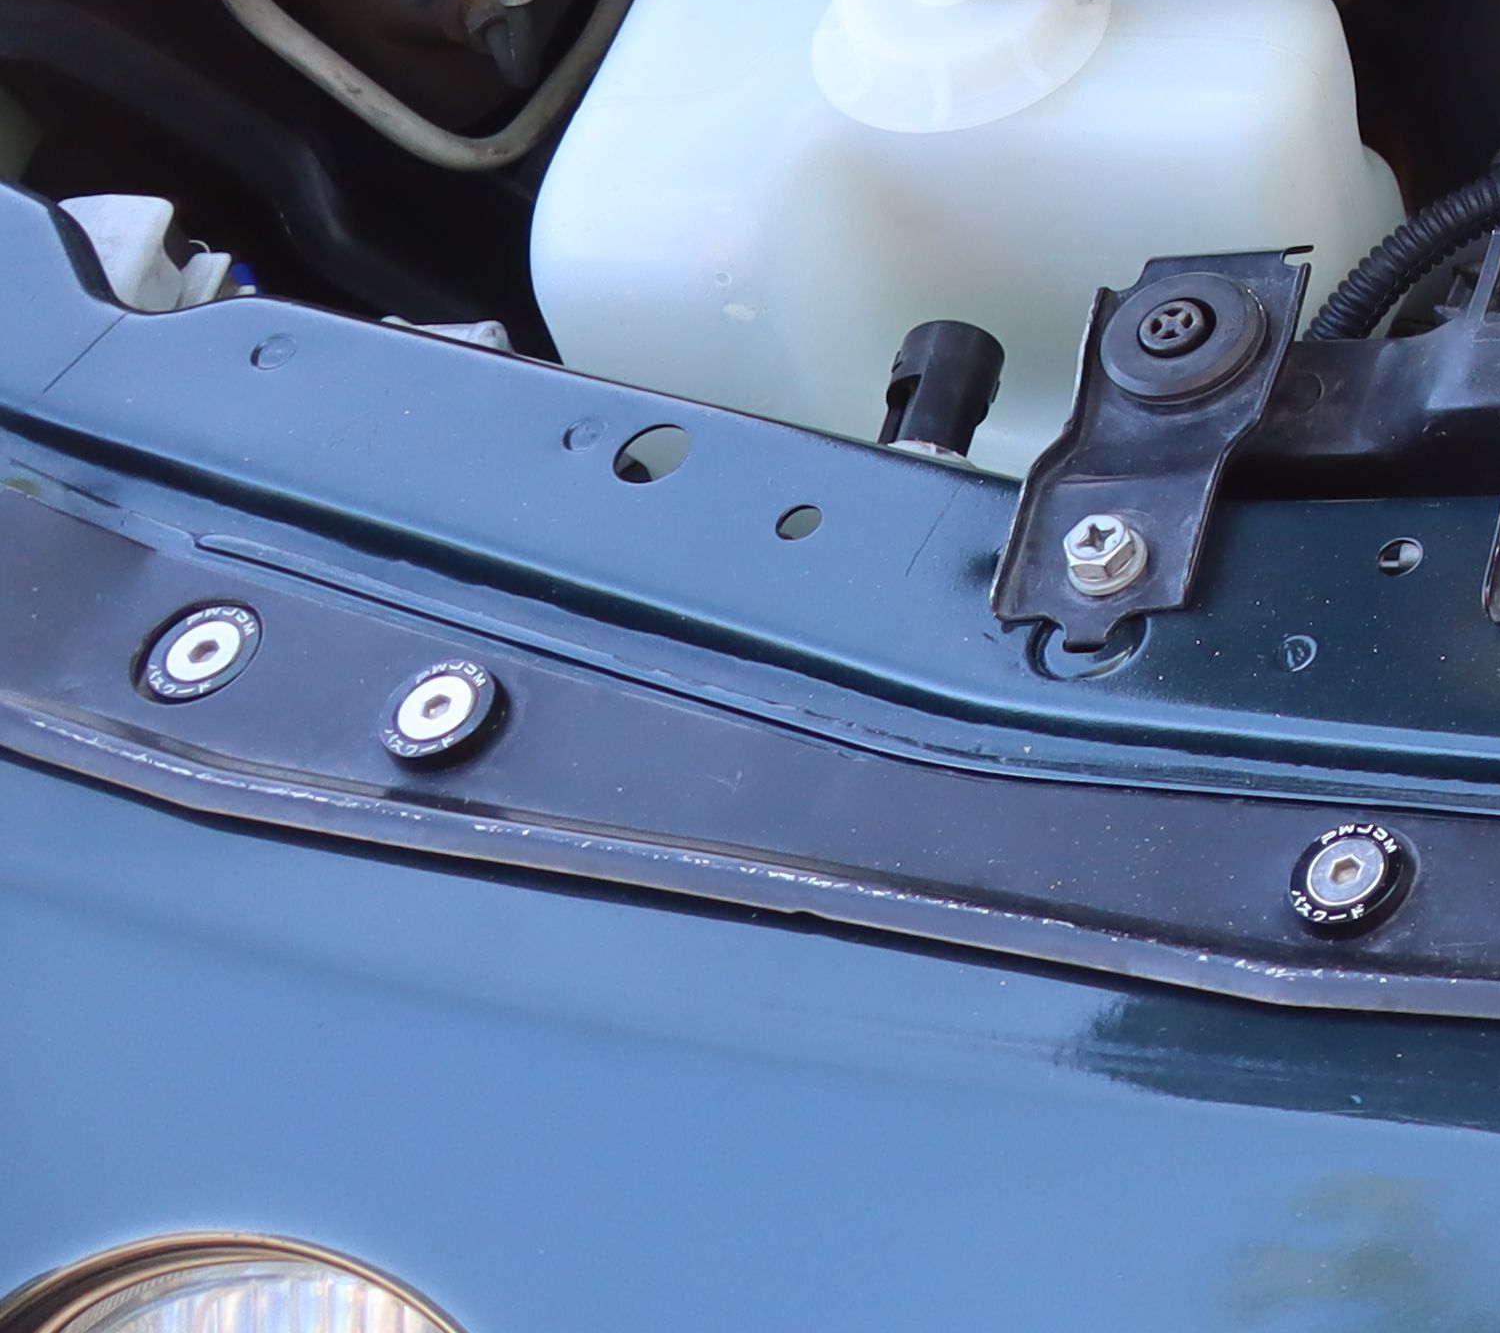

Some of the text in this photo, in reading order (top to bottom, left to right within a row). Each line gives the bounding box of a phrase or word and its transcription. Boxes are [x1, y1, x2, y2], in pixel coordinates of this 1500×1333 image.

[1320, 822, 1399, 855] PWJDM
[1290, 889, 1366, 921] パスワード
